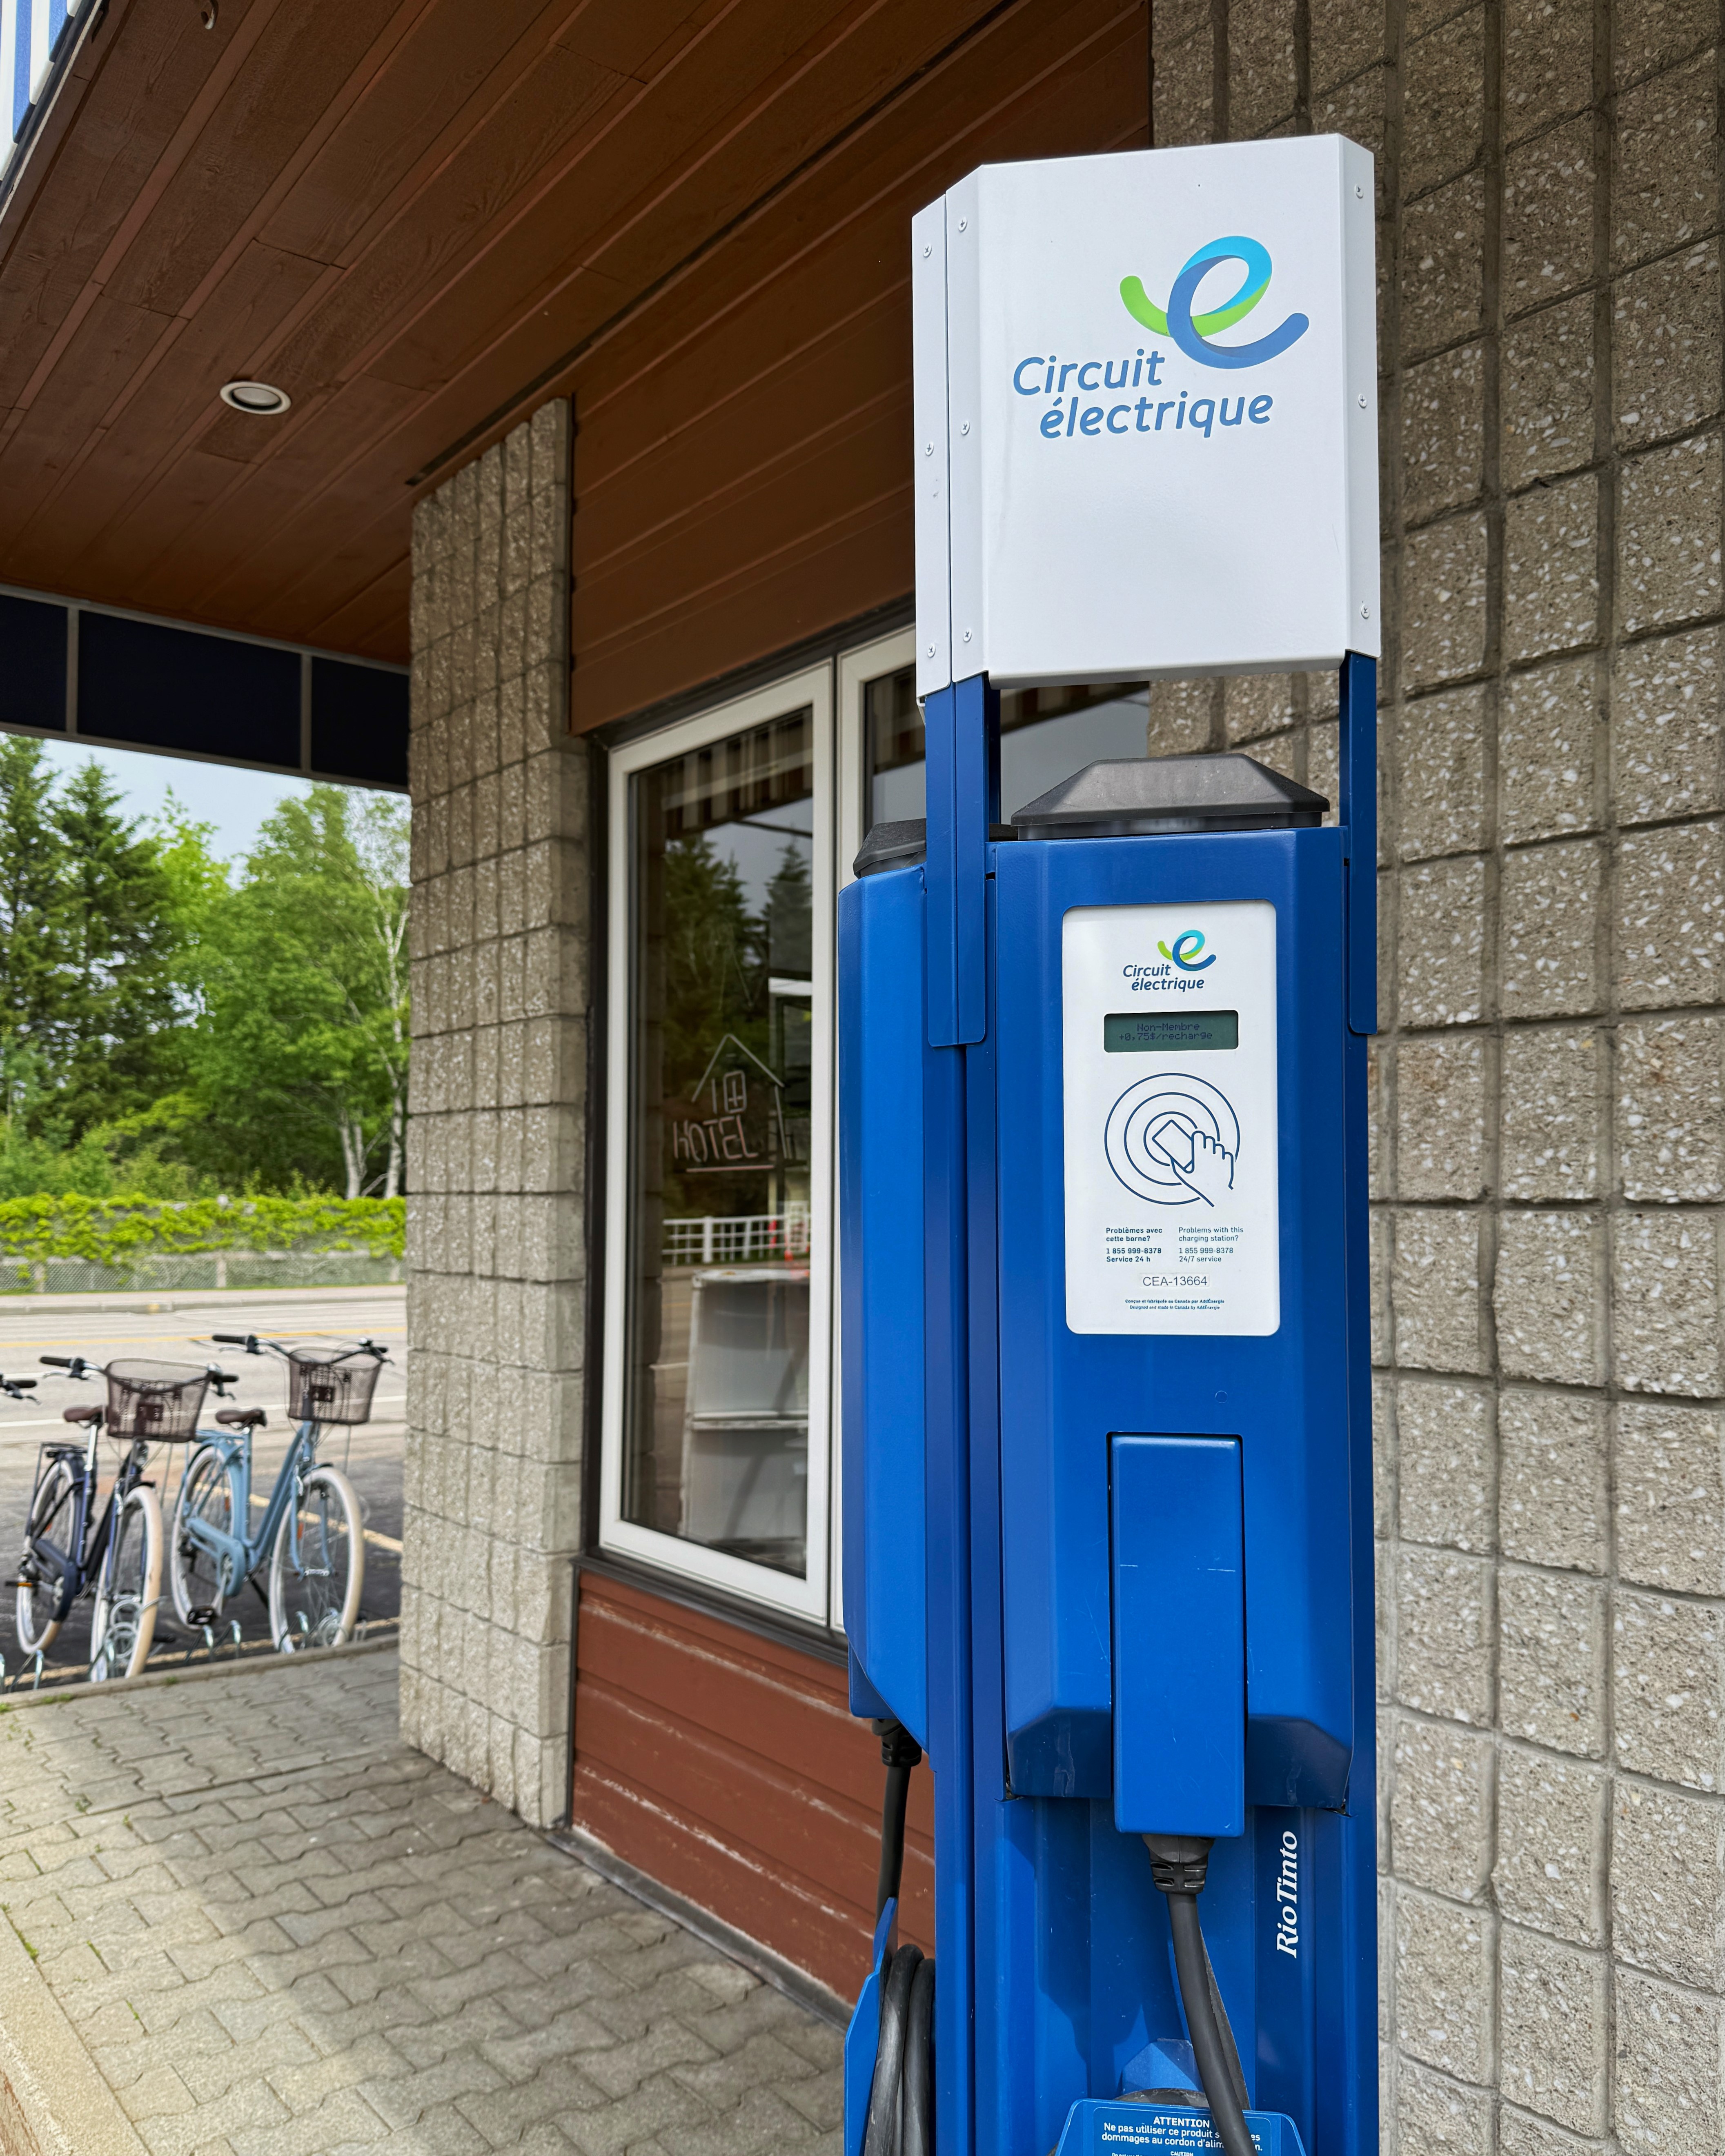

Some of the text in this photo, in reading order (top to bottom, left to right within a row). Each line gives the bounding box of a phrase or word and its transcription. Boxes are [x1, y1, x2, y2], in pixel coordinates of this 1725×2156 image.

[1013, 348, 1165, 396] Circuit
[1039, 391, 1273, 439] électrique
[1123, 963, 1171, 977] Circuit
[1131, 977, 1204, 993] électrique
[1137, 1023, 1200, 1031] Non-Membre
[1119, 1032, 1212, 1041] +0,75$/recharge
[673, 1114, 759, 1162] HOTEL
[1143, 1276, 1207, 1286] CEA-13664
[1277, 1831, 1298, 1958] Rio Tinto
[1153, 2116, 1210, 2128] ATTENTION
[1104, 2122, 1116, 2131] Ne
[1118, 2125, 1134, 2134] pas
[1136, 2125, 1166, 2135] utiliser
[1181, 2129, 1213, 2138] produit
[1102, 2132, 1150, 2145] dommages
[1164, 2138, 1195, 2147] cordon
